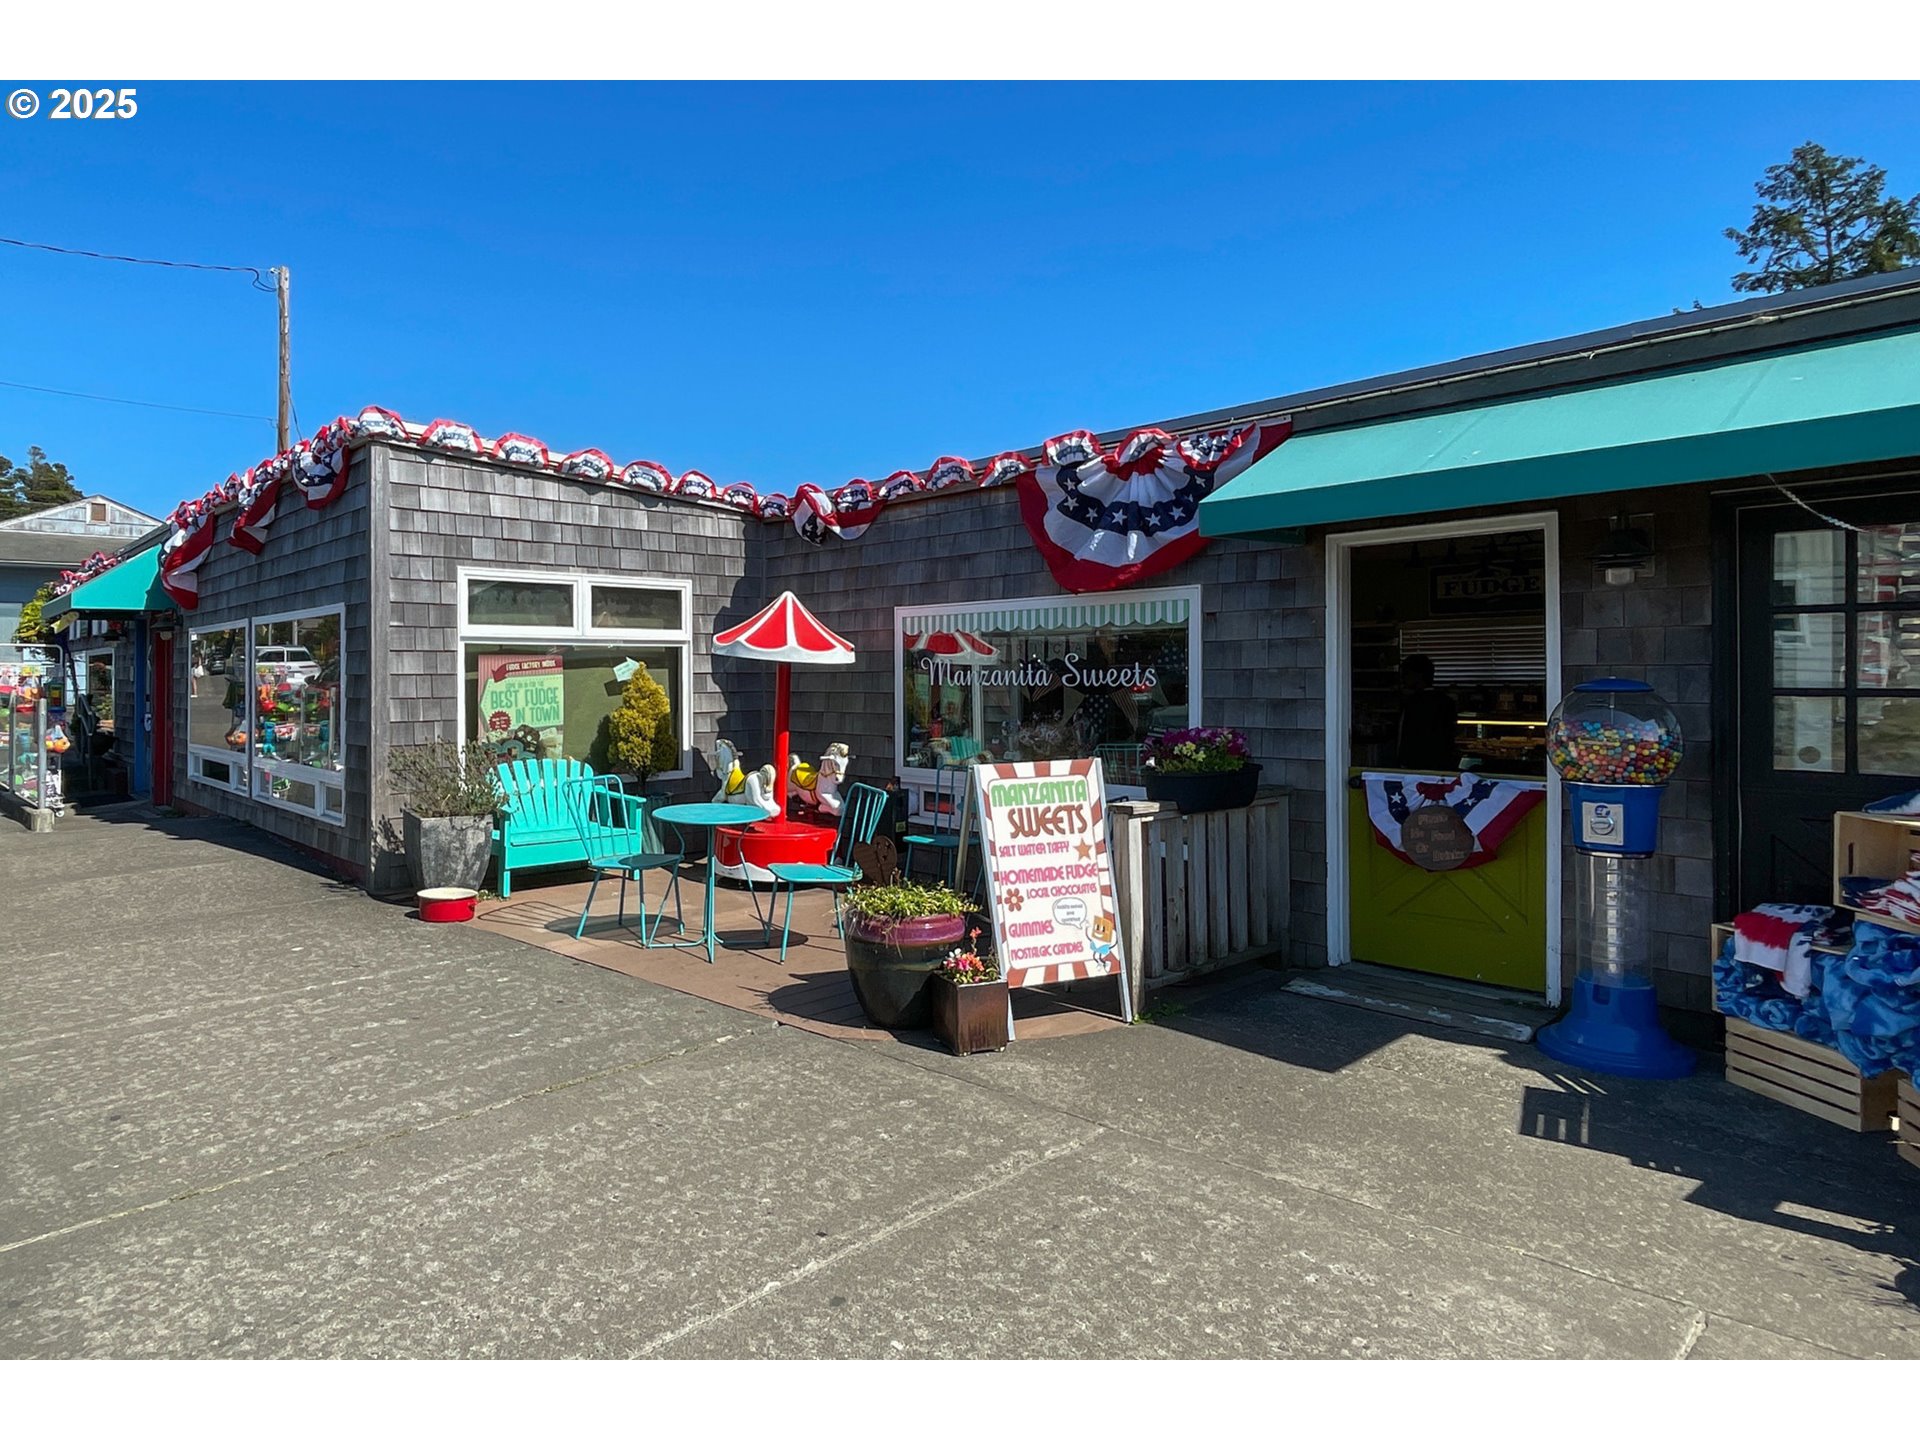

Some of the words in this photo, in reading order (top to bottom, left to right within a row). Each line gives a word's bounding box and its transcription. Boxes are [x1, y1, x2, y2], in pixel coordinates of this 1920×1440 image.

[1443, 576, 1540, 596] FUDGE
[921, 657, 1053, 688] Manzanita
[1062, 653, 1158, 688] Sweets
[491, 690, 519, 709] BEST
[525, 687, 559, 707] FUDGE
[515, 708, 525, 723] IN
[530, 705, 560, 722] TOWN
[991, 780, 1088, 807] MANZANITA
[1007, 804, 1087, 838] SWEETS
[999, 844, 1017, 857] SALT
[1018, 842, 1046, 855] WATER
[1047, 841, 1070, 853] TAFFY
[1000, 865, 1065, 886] HOMEMADE
[1065, 863, 1098, 880] FUDGE
[1026, 887, 1050, 899] LOCAL
[1050, 883, 1097, 896] CHOCOLATES
[1009, 920, 1054, 938] GUMMIES
[1011, 945, 1052, 960] NOSTALGIC
[1052, 942, 1084, 955] CANDIES
